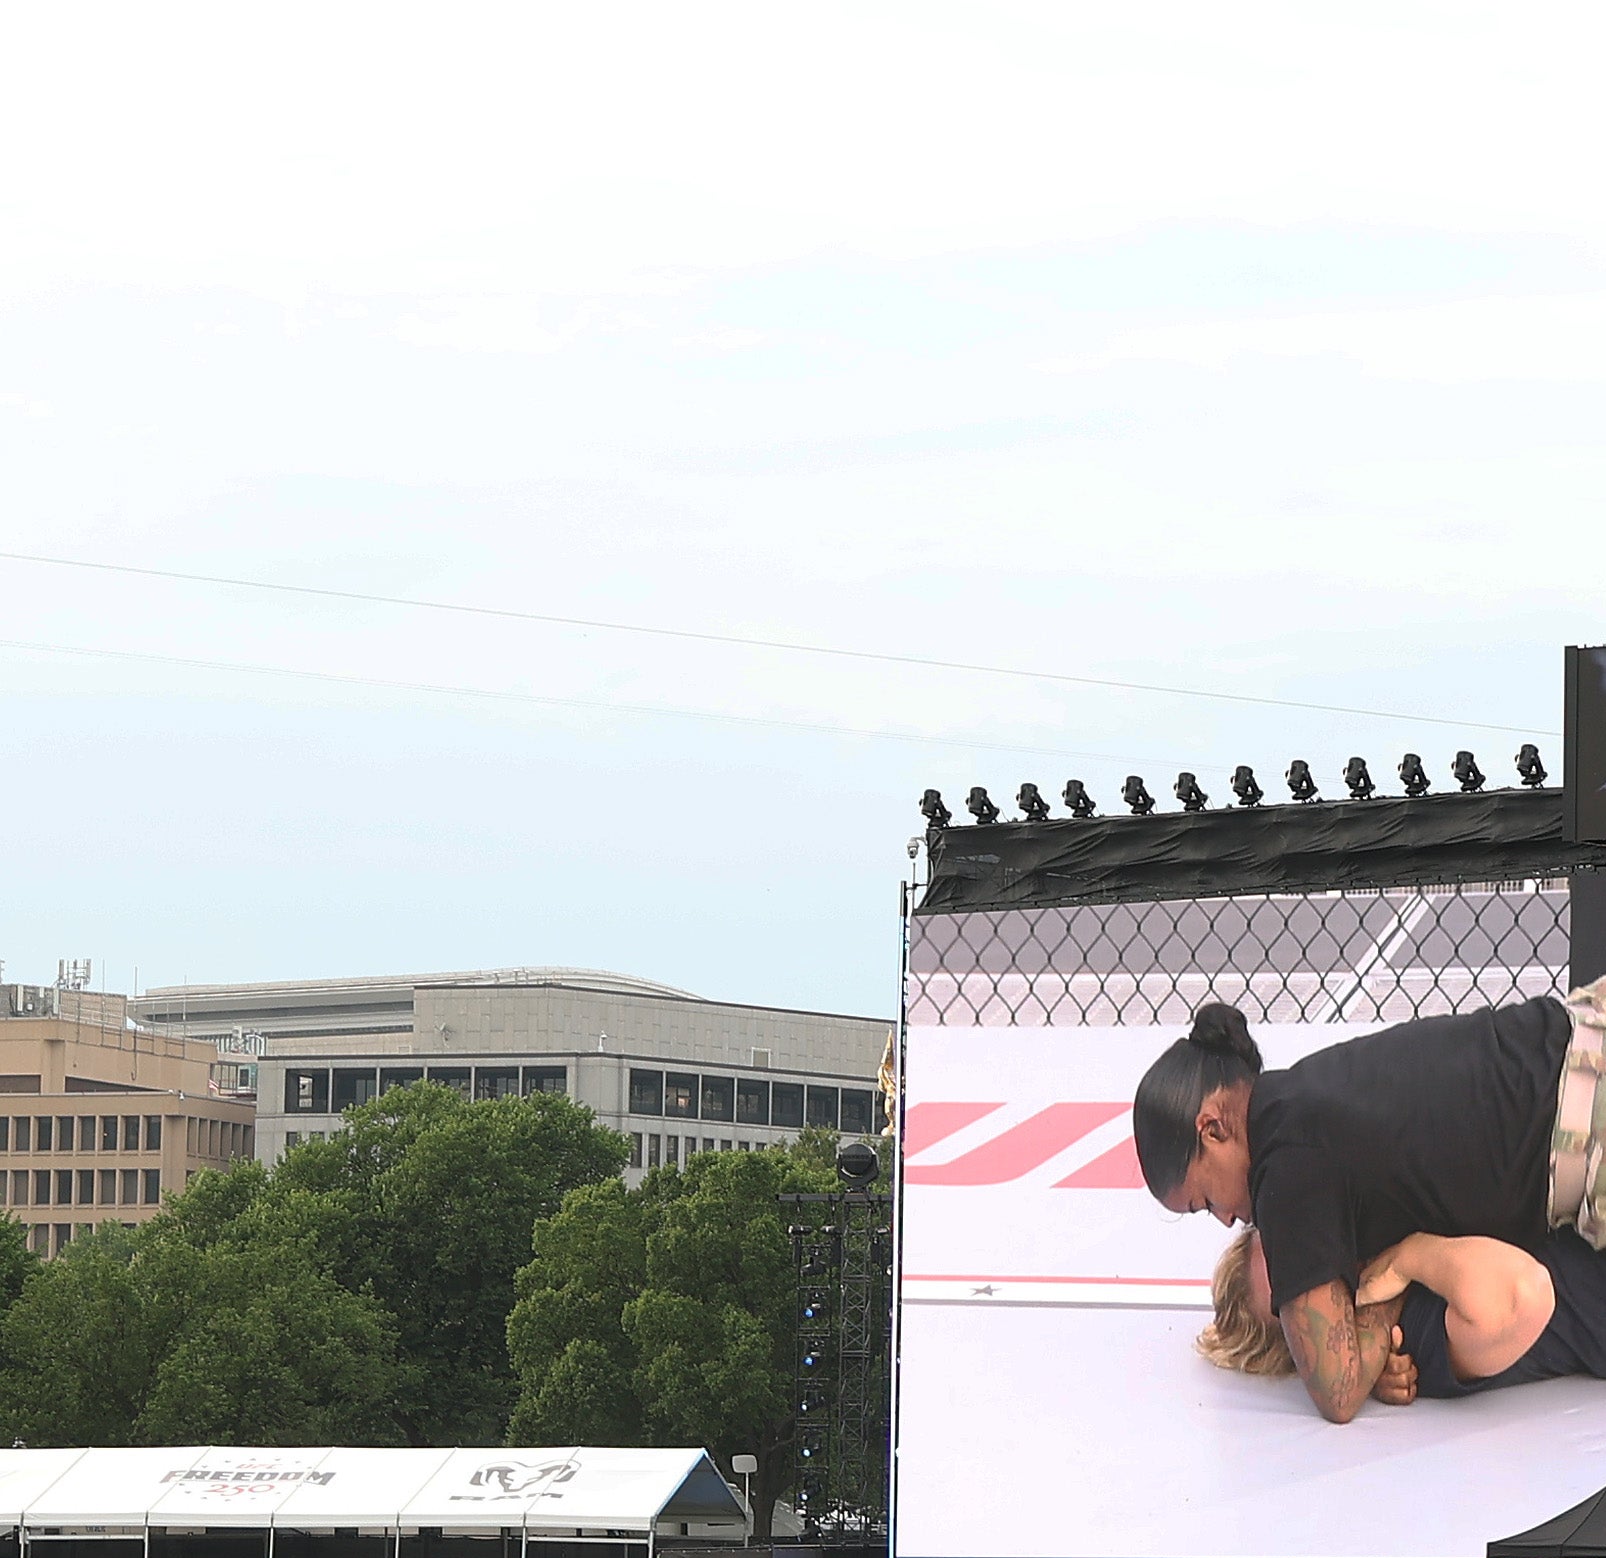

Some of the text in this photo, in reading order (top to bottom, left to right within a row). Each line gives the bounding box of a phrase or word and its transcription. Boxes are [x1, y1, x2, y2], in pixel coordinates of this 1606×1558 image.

[159, 1470, 337, 1486] FREEDOM
[204, 1483, 275, 1497] 250
[450, 1492, 563, 1502] RAM
